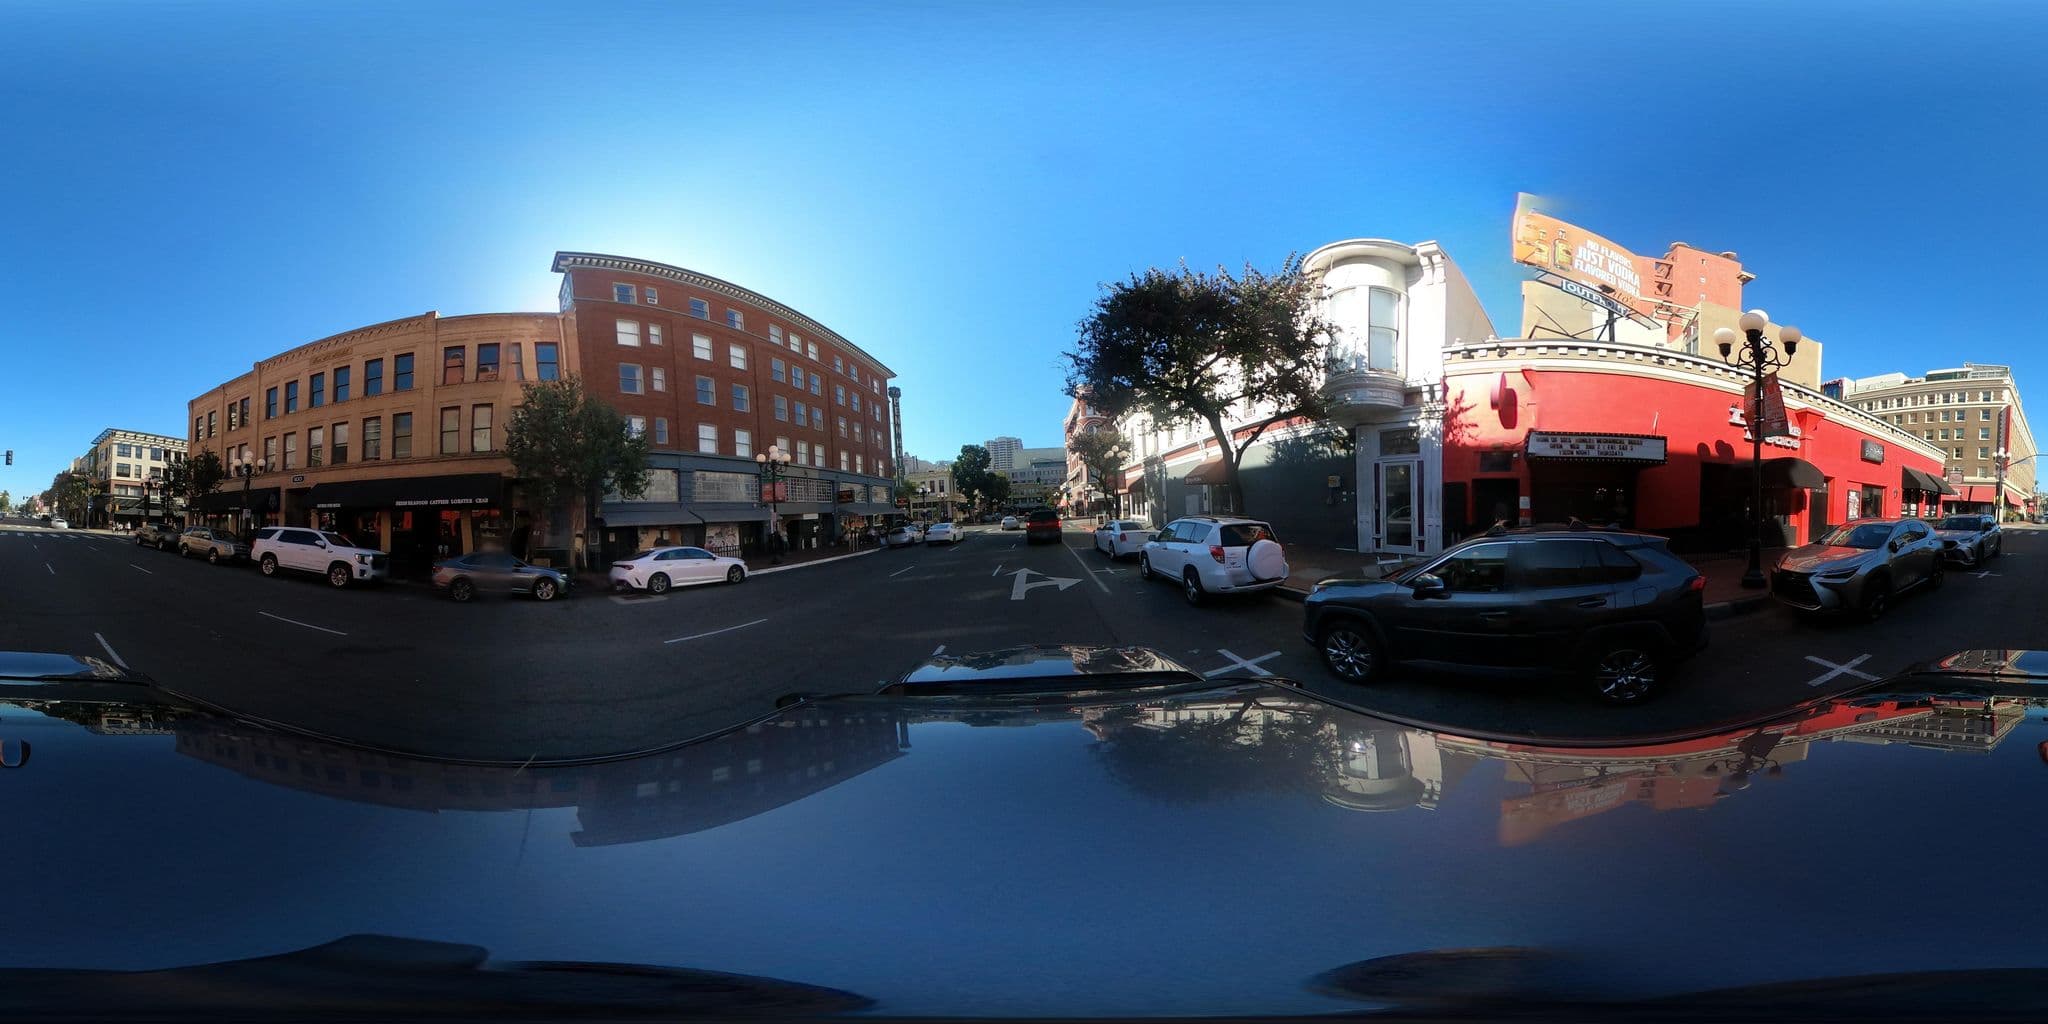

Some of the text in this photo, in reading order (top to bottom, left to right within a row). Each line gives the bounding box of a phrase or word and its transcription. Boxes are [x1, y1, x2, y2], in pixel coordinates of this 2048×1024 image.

[1587, 240, 1599, 252] NO
[1573, 259, 1616, 285] FLAVORED
[1578, 246, 1604, 267] JUST
[1608, 258, 1640, 288] VODKA
